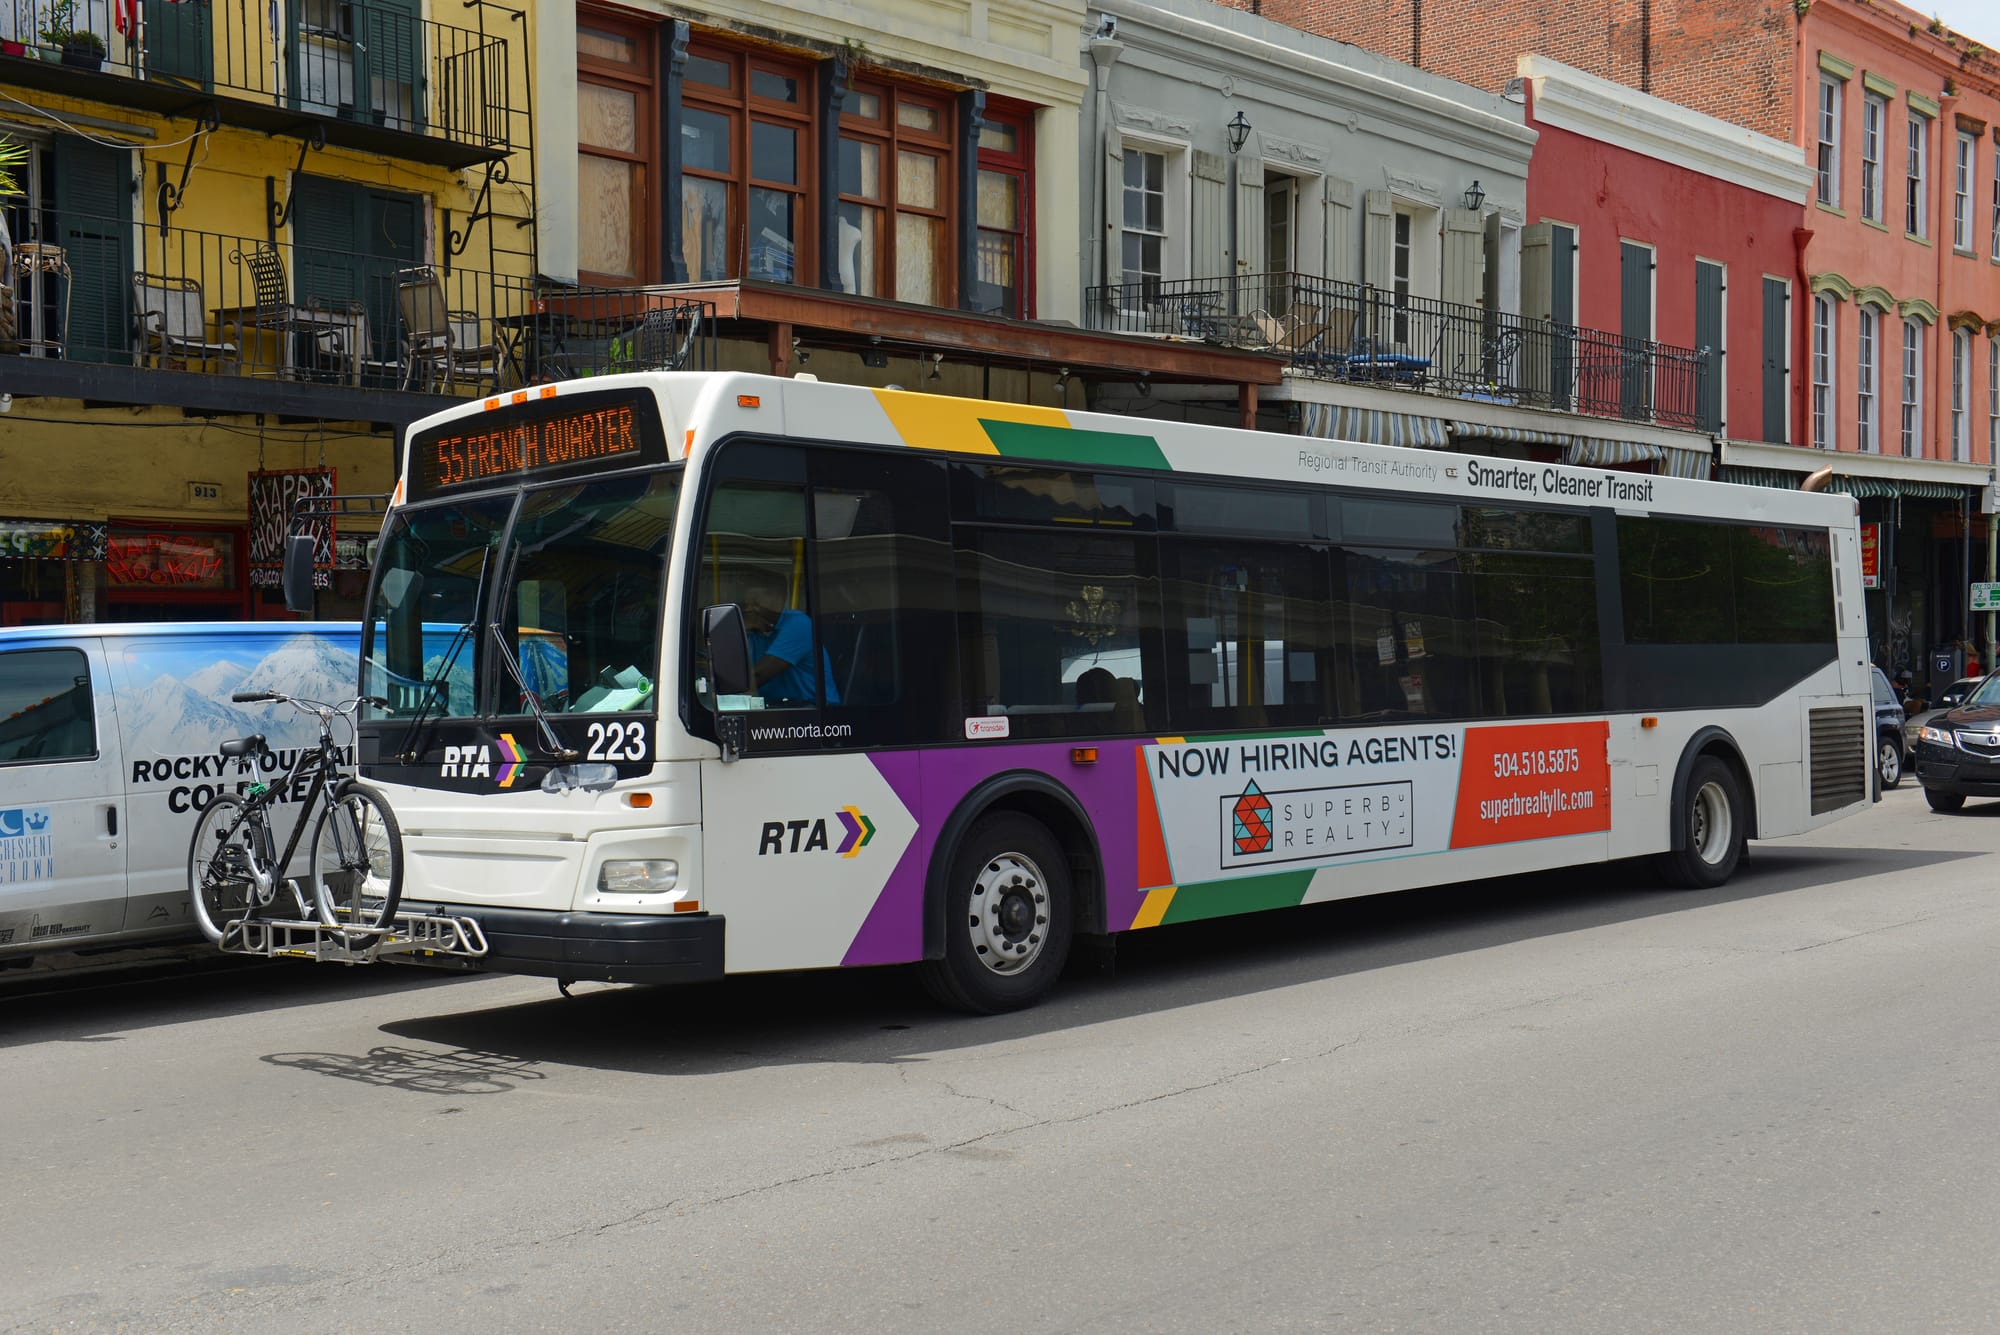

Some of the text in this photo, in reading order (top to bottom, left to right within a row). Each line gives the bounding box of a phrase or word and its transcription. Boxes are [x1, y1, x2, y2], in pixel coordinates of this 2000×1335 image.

[437, 406, 635, 485] 55 FRENCH QUARTER
[1298, 450, 1438, 483] Regional Transit Authority
[1467, 459, 1654, 503] Smarter, Cleaner Transit
[194, 487, 217, 498] 913
[107, 556, 223, 585] HOOKAH
[250, 568, 280, 586] TOBACCO
[586, 721, 647, 761] 223
[751, 723, 852, 741] www.norta.com
[132, 755, 229, 783] ROCKY
[441, 745, 492, 778] RTA
[1158, 734, 1457, 779] NOW HIRING AGENTS!
[1493, 748, 1579, 778] 504.518.5875
[1284, 795, 1390, 821] SUPERB
[1480, 788, 1593, 824] superbrealtyllc.com
[758, 818, 829, 855] RTA
[1284, 820, 1390, 847] REALTY
